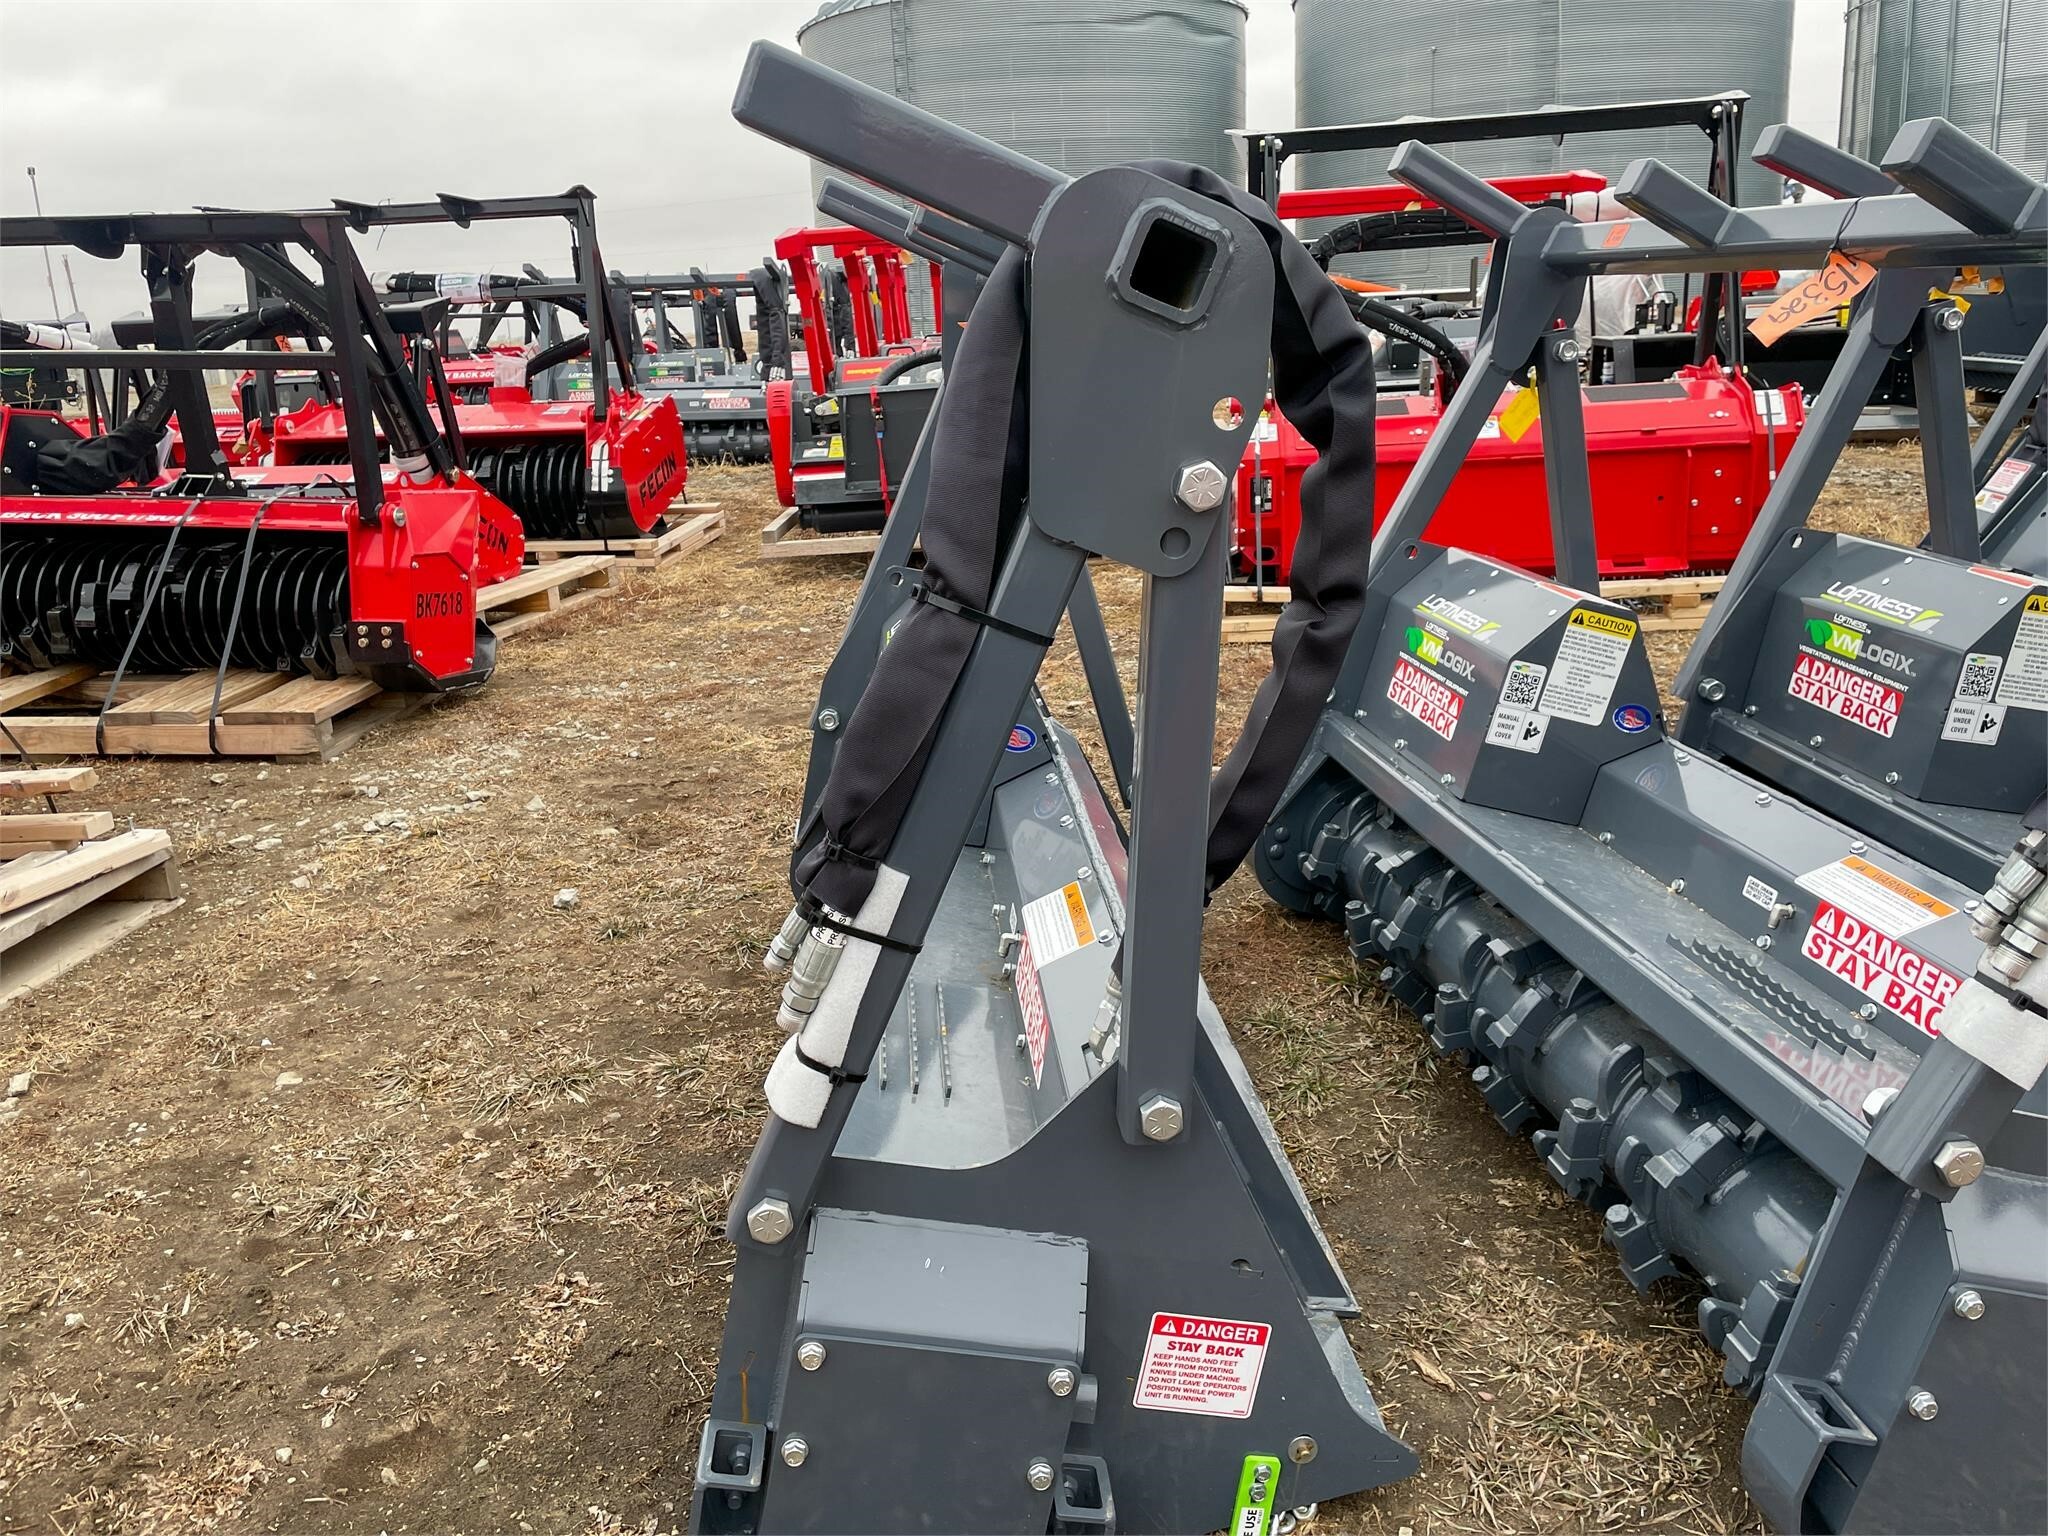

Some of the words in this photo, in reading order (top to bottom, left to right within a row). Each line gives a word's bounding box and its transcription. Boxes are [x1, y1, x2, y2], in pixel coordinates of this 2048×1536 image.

[638, 452, 678, 509] FECON
[479, 516, 510, 556] CON
[416, 591, 463, 619] BK7618
[1827, 581, 1923, 620] LOFTNESS
[1422, 593, 1488, 630] LOFTNESS
[1588, 615, 1632, 633] CAUTION
[1833, 613, 1868, 631] LOFTNESS
[1421, 639, 1475, 681] VMLOGIX
[1832, 630, 1914, 676] VMLOGIX
[1404, 667, 1453, 712] DANGER
[1810, 660, 1885, 708] DANGER
[1390, 680, 1421, 713] STAY
[1419, 701, 1454, 738] BACK
[1792, 676, 1838, 709] STAY
[1840, 694, 1894, 735] BACK
[1953, 707, 1976, 717] MANUAL
[1497, 722, 1515, 731] UNDER
[1498, 712, 1520, 723] MANUAL
[1953, 716, 1971, 725] UNDER
[1494, 731, 1512, 740] COVER
[1950, 725, 1968, 734] COVER
[1872, 871, 1920, 900] WARNING
[1836, 916, 1958, 1008] DANGER
[1808, 932, 1883, 992] STAY
[1883, 979, 1945, 1038] BAC
[1182, 1321, 1259, 1342] DANGER
[1167, 1340, 1202, 1354] STAY
[1205, 1343, 1245, 1358] BACK
[1151, 1360, 1173, 1369] AWAY
[1174, 1362, 1196, 1371] FROM
[1197, 1365, 1234, 1375] ROTATING
[1174, 1355, 1201, 1363] HANDS
[1202, 1357, 1218, 1366] AND
[1219, 1359, 1238, 1367] FEET
[1150, 1368, 1177, 1377] KNIVES
[1178, 1371, 1204, 1379] UNDER
[1206, 1374, 1240, 1383] MACHINE
[1161, 1377, 1176, 1385] NOT
[1178, 1379, 1202, 1388] LEAVE
[1202, 1381, 1248, 1392] OPERATORS
[1146, 1383, 1182, 1393] POSITION
[1183, 1387, 1206, 1396] WHILE
[1207, 1390, 1235, 1398] POWER
[1172, 1394, 1208, 1403] RUNNING.
[1244, 1509, 1258, 1529] USE
